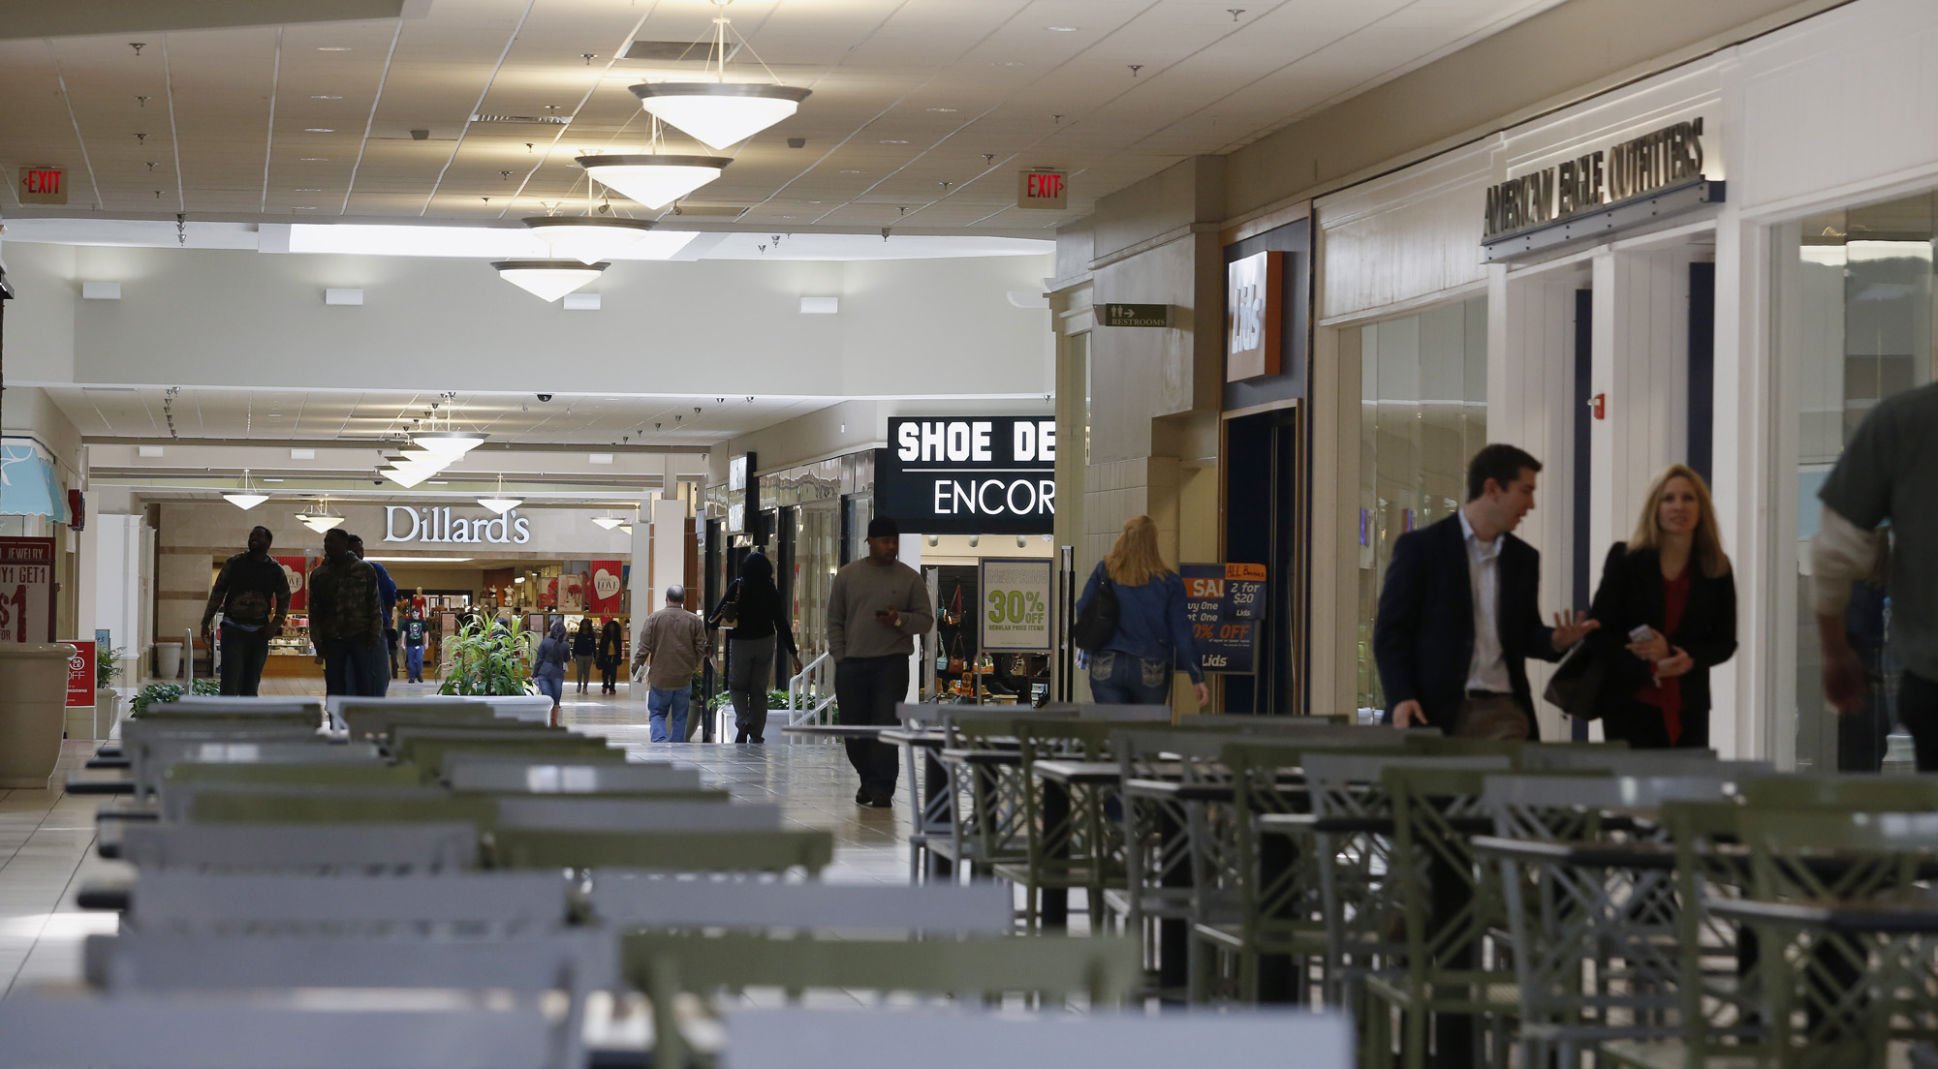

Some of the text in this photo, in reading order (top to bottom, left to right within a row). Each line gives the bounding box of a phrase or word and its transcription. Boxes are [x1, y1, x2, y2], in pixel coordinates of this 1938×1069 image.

[28, 170, 61, 194] EXIT
[1027, 174, 1060, 198] EXIT
[1484, 116, 1704, 236] AMERICAN EAGLE OUTFITTERS
[1231, 284, 1261, 354] Lids
[898, 421, 1056, 462] SHOE DE
[934, 479, 1056, 515] ENCOR
[383, 505, 530, 544] Dillard's
[9, 547, 43, 560] JEWELRY
[1231, 582, 1260, 593] 2 for
[1233, 592, 1254, 604] $20
[988, 590, 1045, 624] 30% OFF
[1200, 613, 1218, 622] One
[1201, 602, 1218, 610] One
[1221, 624, 1249, 639] OFF
[1202, 654, 1227, 667] Lids
